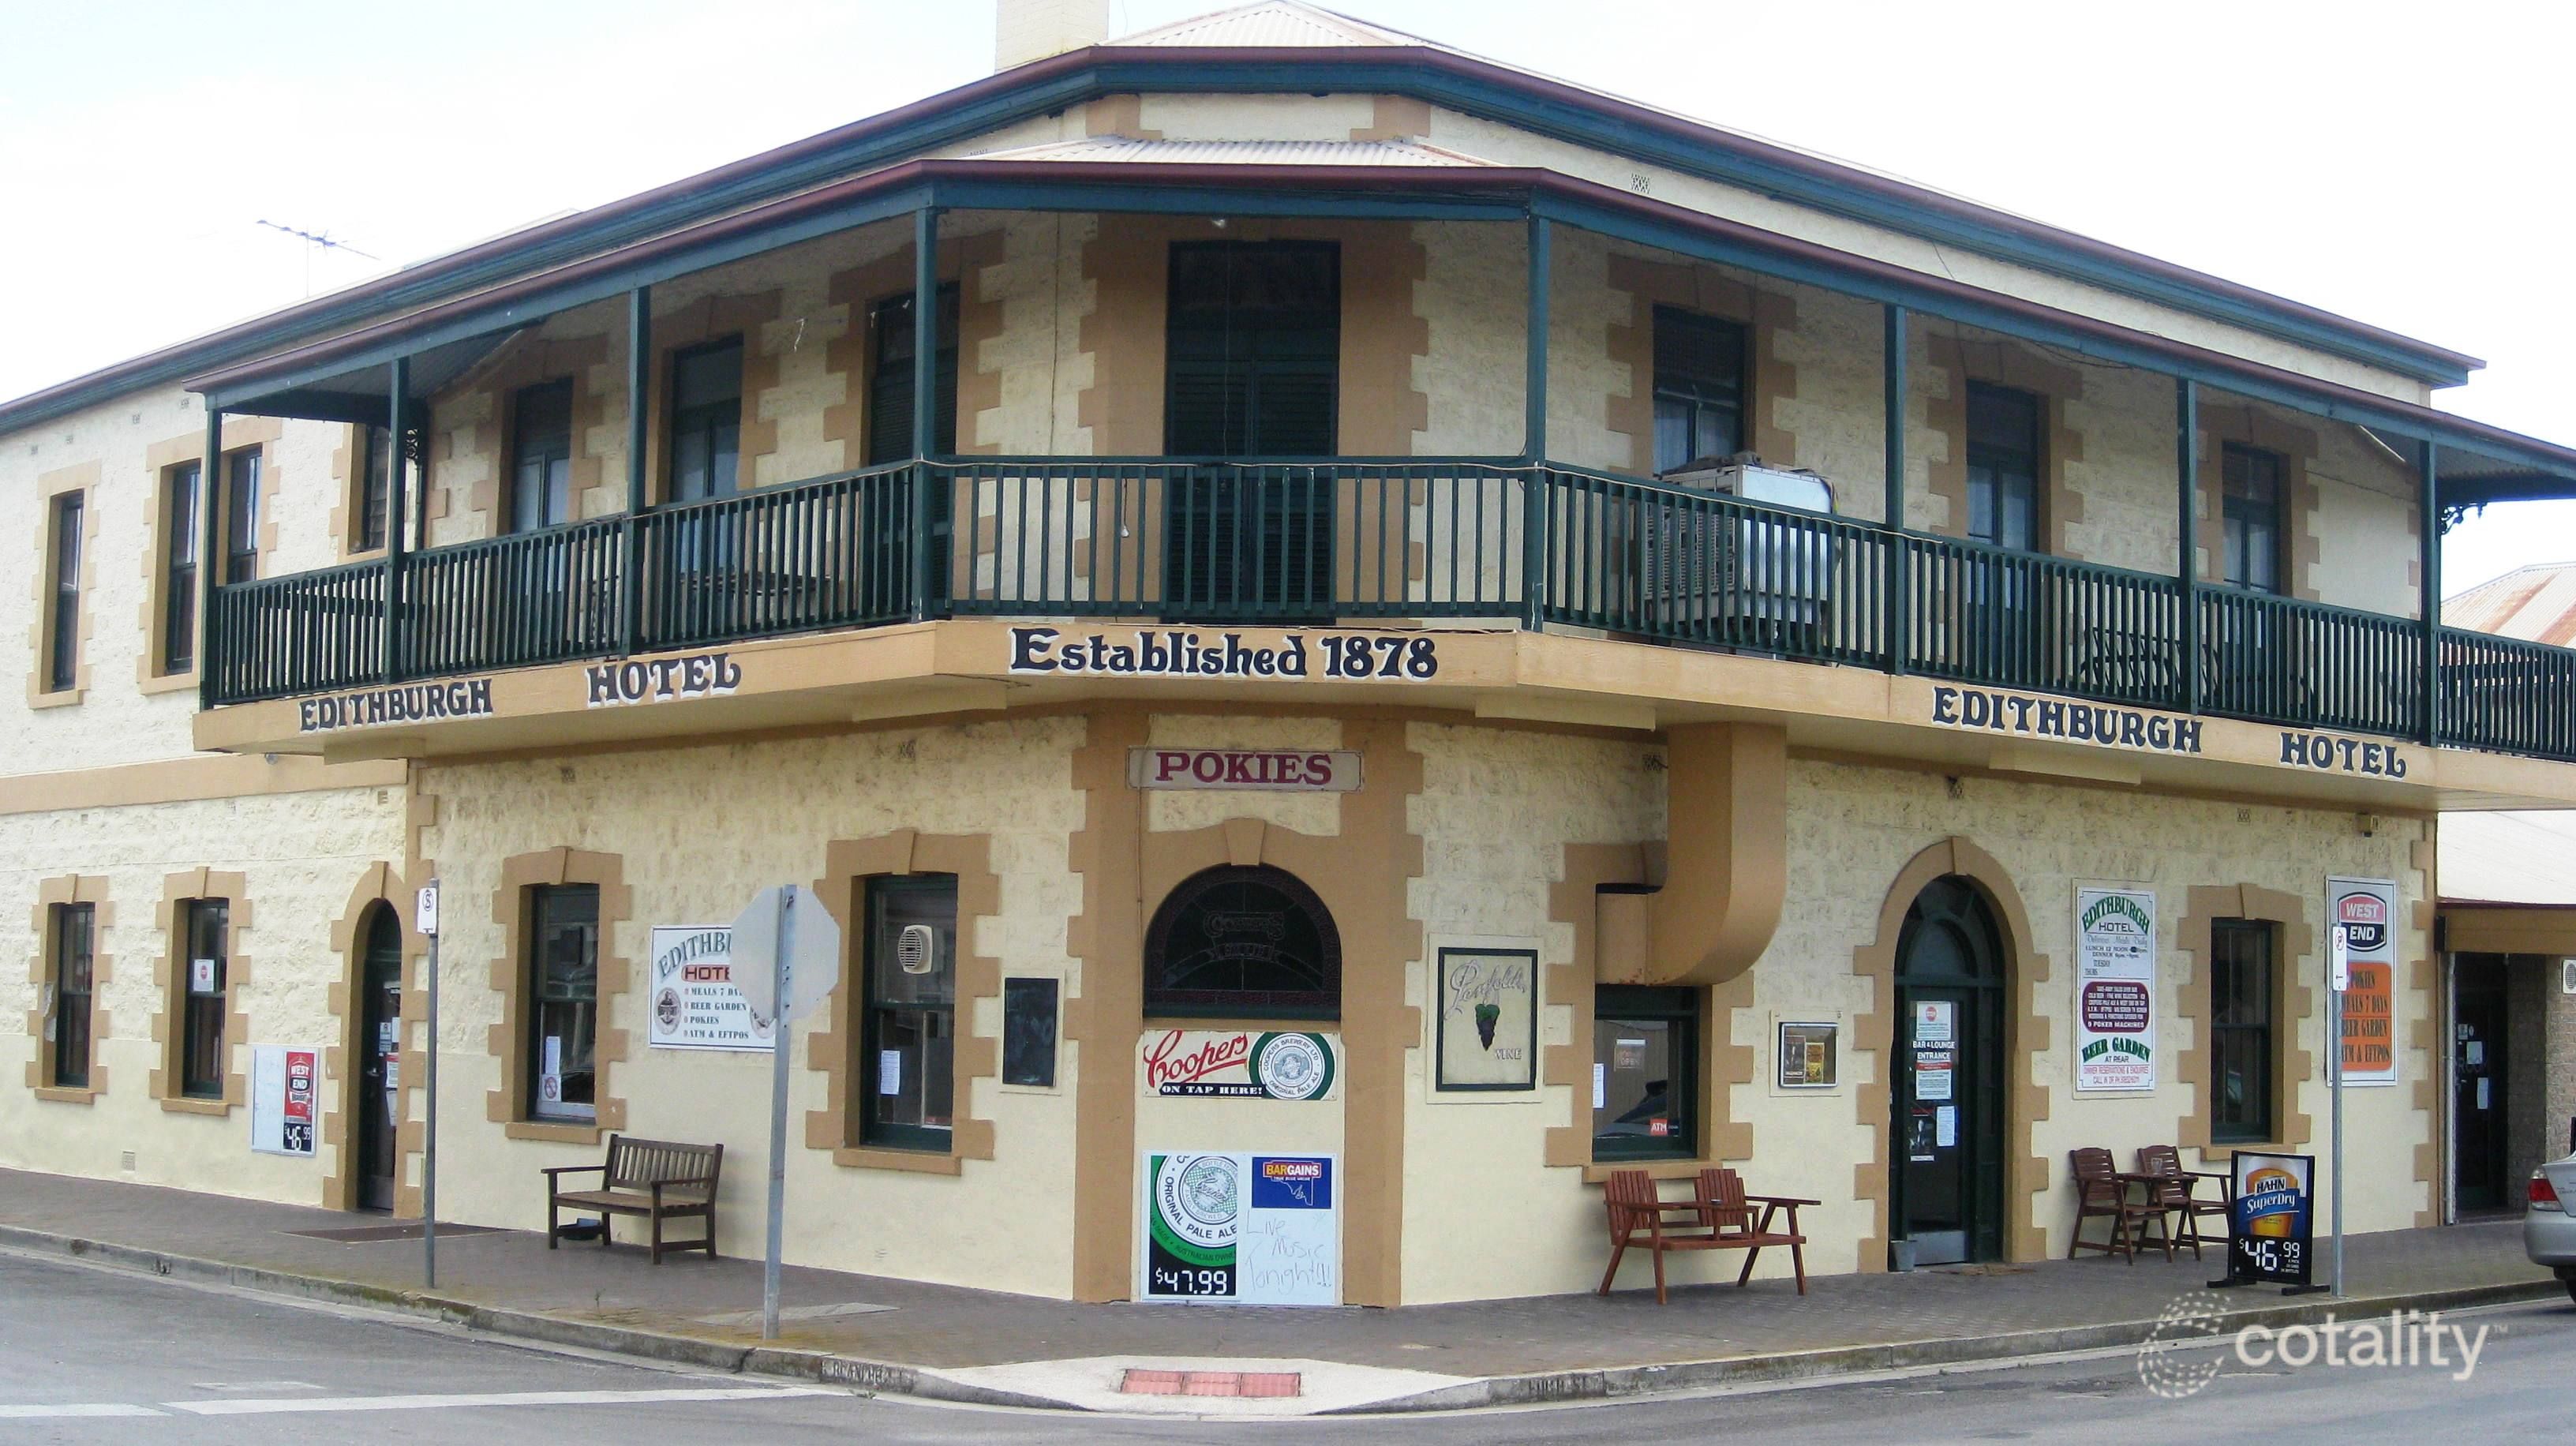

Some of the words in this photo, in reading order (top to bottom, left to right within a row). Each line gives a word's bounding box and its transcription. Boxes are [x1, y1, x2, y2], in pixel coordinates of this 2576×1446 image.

[1008, 627, 1308, 679] Established
[1317, 635, 1438, 682] 1878
[298, 679, 494, 734] EDITHBURGH
[585, 653, 742, 709] HOTEL
[1931, 685, 2203, 754] EDITHBURGH
[2280, 732, 2407, 780] HOTEL
[1155, 751, 1332, 785] POKIES
[2082, 896, 2150, 936] EDITHBURGH
[2346, 901, 2379, 919] WEST
[2099, 922, 2135, 933] HOTEL
[2349, 925, 2376, 942] END
[2350, 971, 2376, 990] POKIES
[691, 987, 717, 996] MEALS
[720, 987, 725, 996] 7
[691, 1002, 711, 1010] BEER
[714, 1002, 747, 1011] GARDEN
[690, 1015, 720, 1025] POKIES
[2361, 1019, 2387, 1037] GARDEN
[687, 1029, 706, 1039] ATM
[708, 1030, 715, 1039] &
[717, 1030, 750, 1040] EFTPOS
[1912, 1040, 1926, 1049] BAR
[2082, 1039, 2109, 1063] BEER
[2113, 1037, 2151, 1063] GARDEN
[2364, 1044, 2391, 1063] EFTPOS
[1144, 1029, 1248, 1088] Coopers
[1264, 1043, 1279, 1071] COOPERS
[1917, 1051, 1951, 1060] ENTRANCE
[1162, 1084, 1178, 1094] ON
[1185, 1084, 1214, 1095] TAP
[1219, 1085, 1264, 1096] HERE!
[1650, 1122, 1668, 1133] ATM
[1266, 1164, 1319, 1176] BARGAINS
[2256, 1178, 2286, 1194] HAHN
[1164, 1176, 1184, 1226] ORIGINAL
[1186, 1223, 1213, 1239] PALE
[1218, 1224, 1237, 1239] ALE
[2238, 1238, 2301, 1272] $46.99
[1155, 1267, 1228, 1295] $47.99
